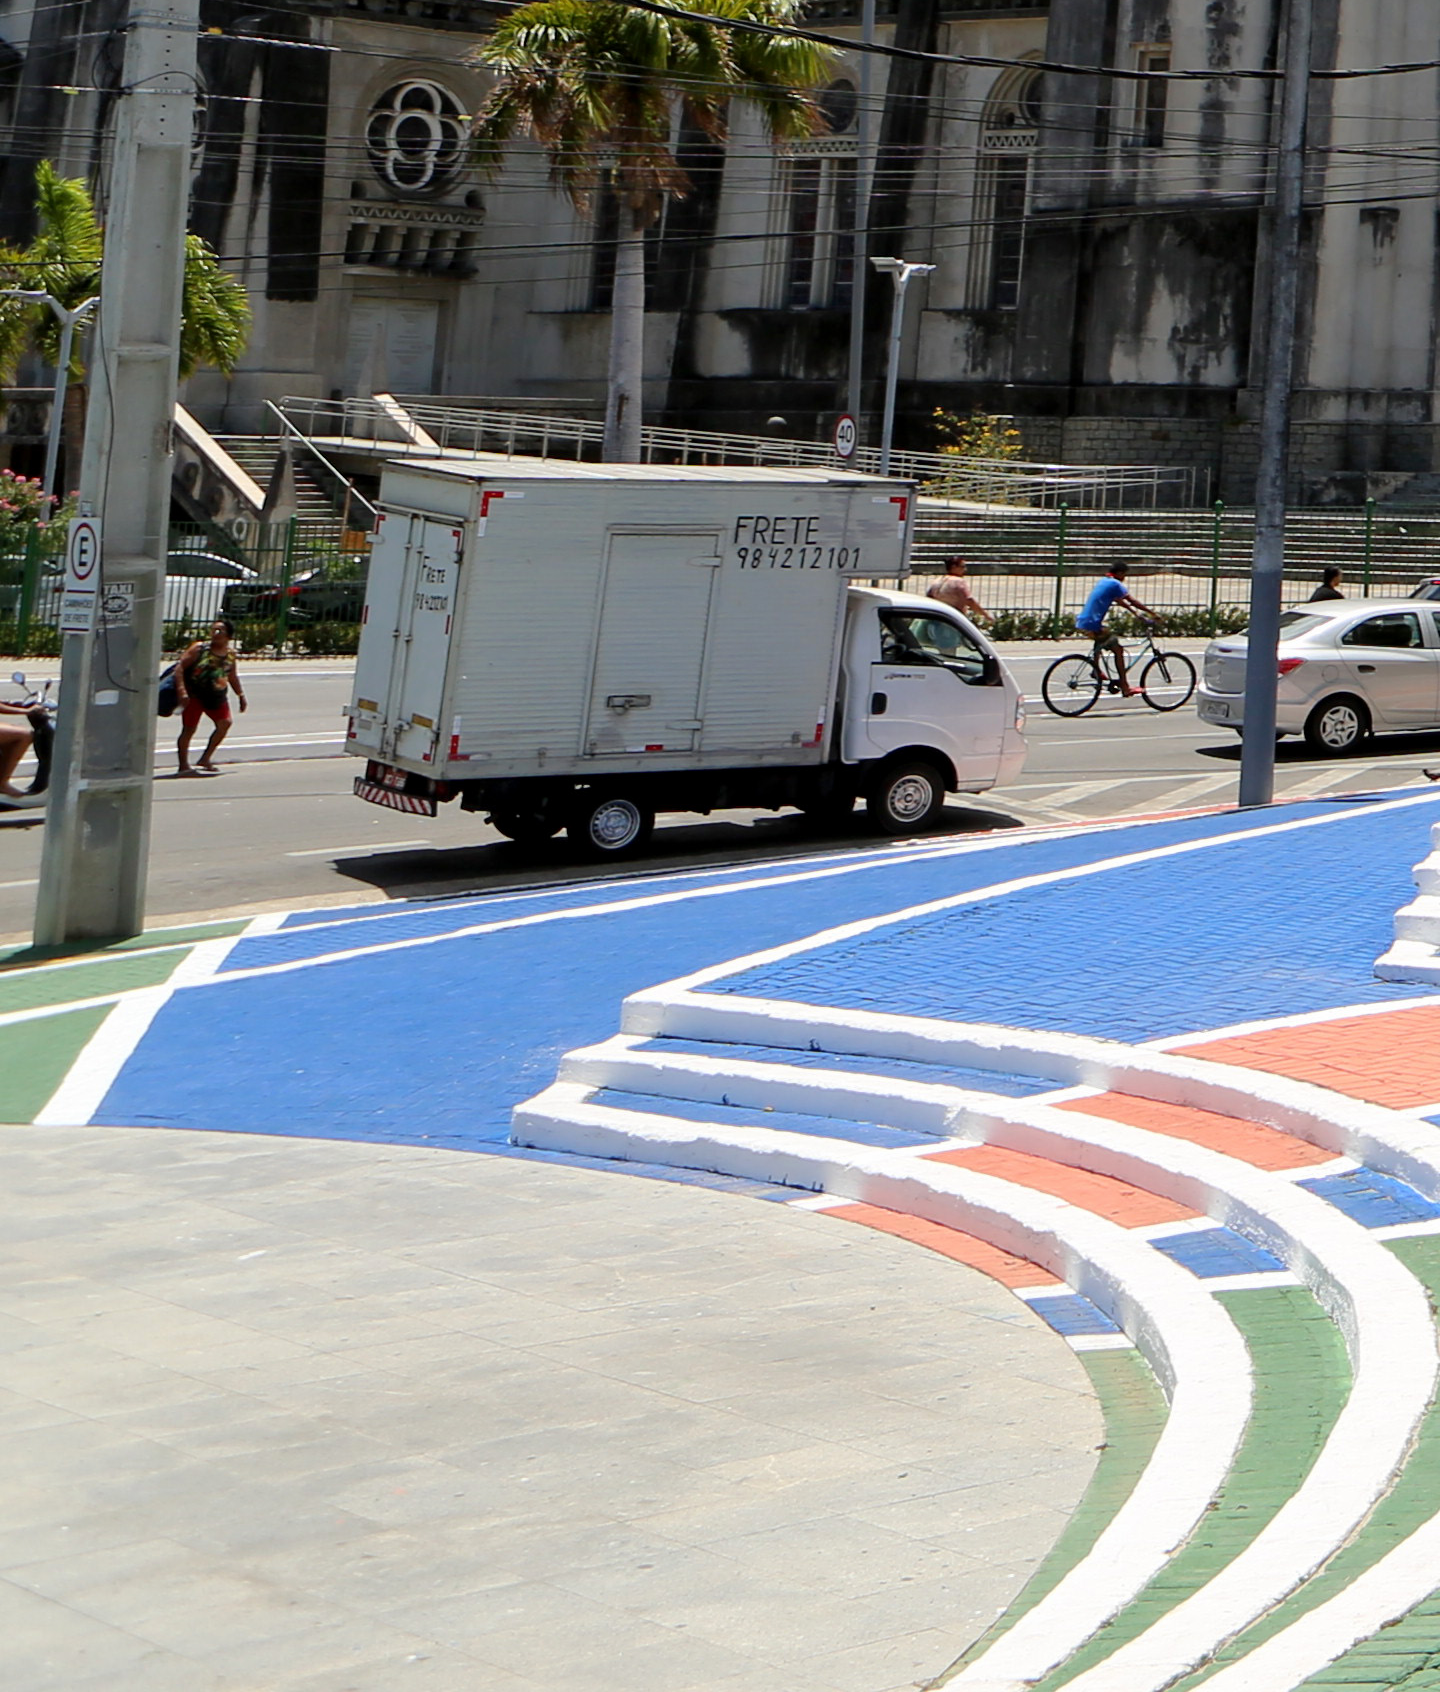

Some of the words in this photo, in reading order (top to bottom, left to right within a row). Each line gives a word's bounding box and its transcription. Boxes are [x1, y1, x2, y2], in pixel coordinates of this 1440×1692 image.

[838, 425, 852, 443] 40
[734, 515, 820, 545] FRETE
[78, 536, 89, 567] E
[737, 547, 861, 569] 984212101
